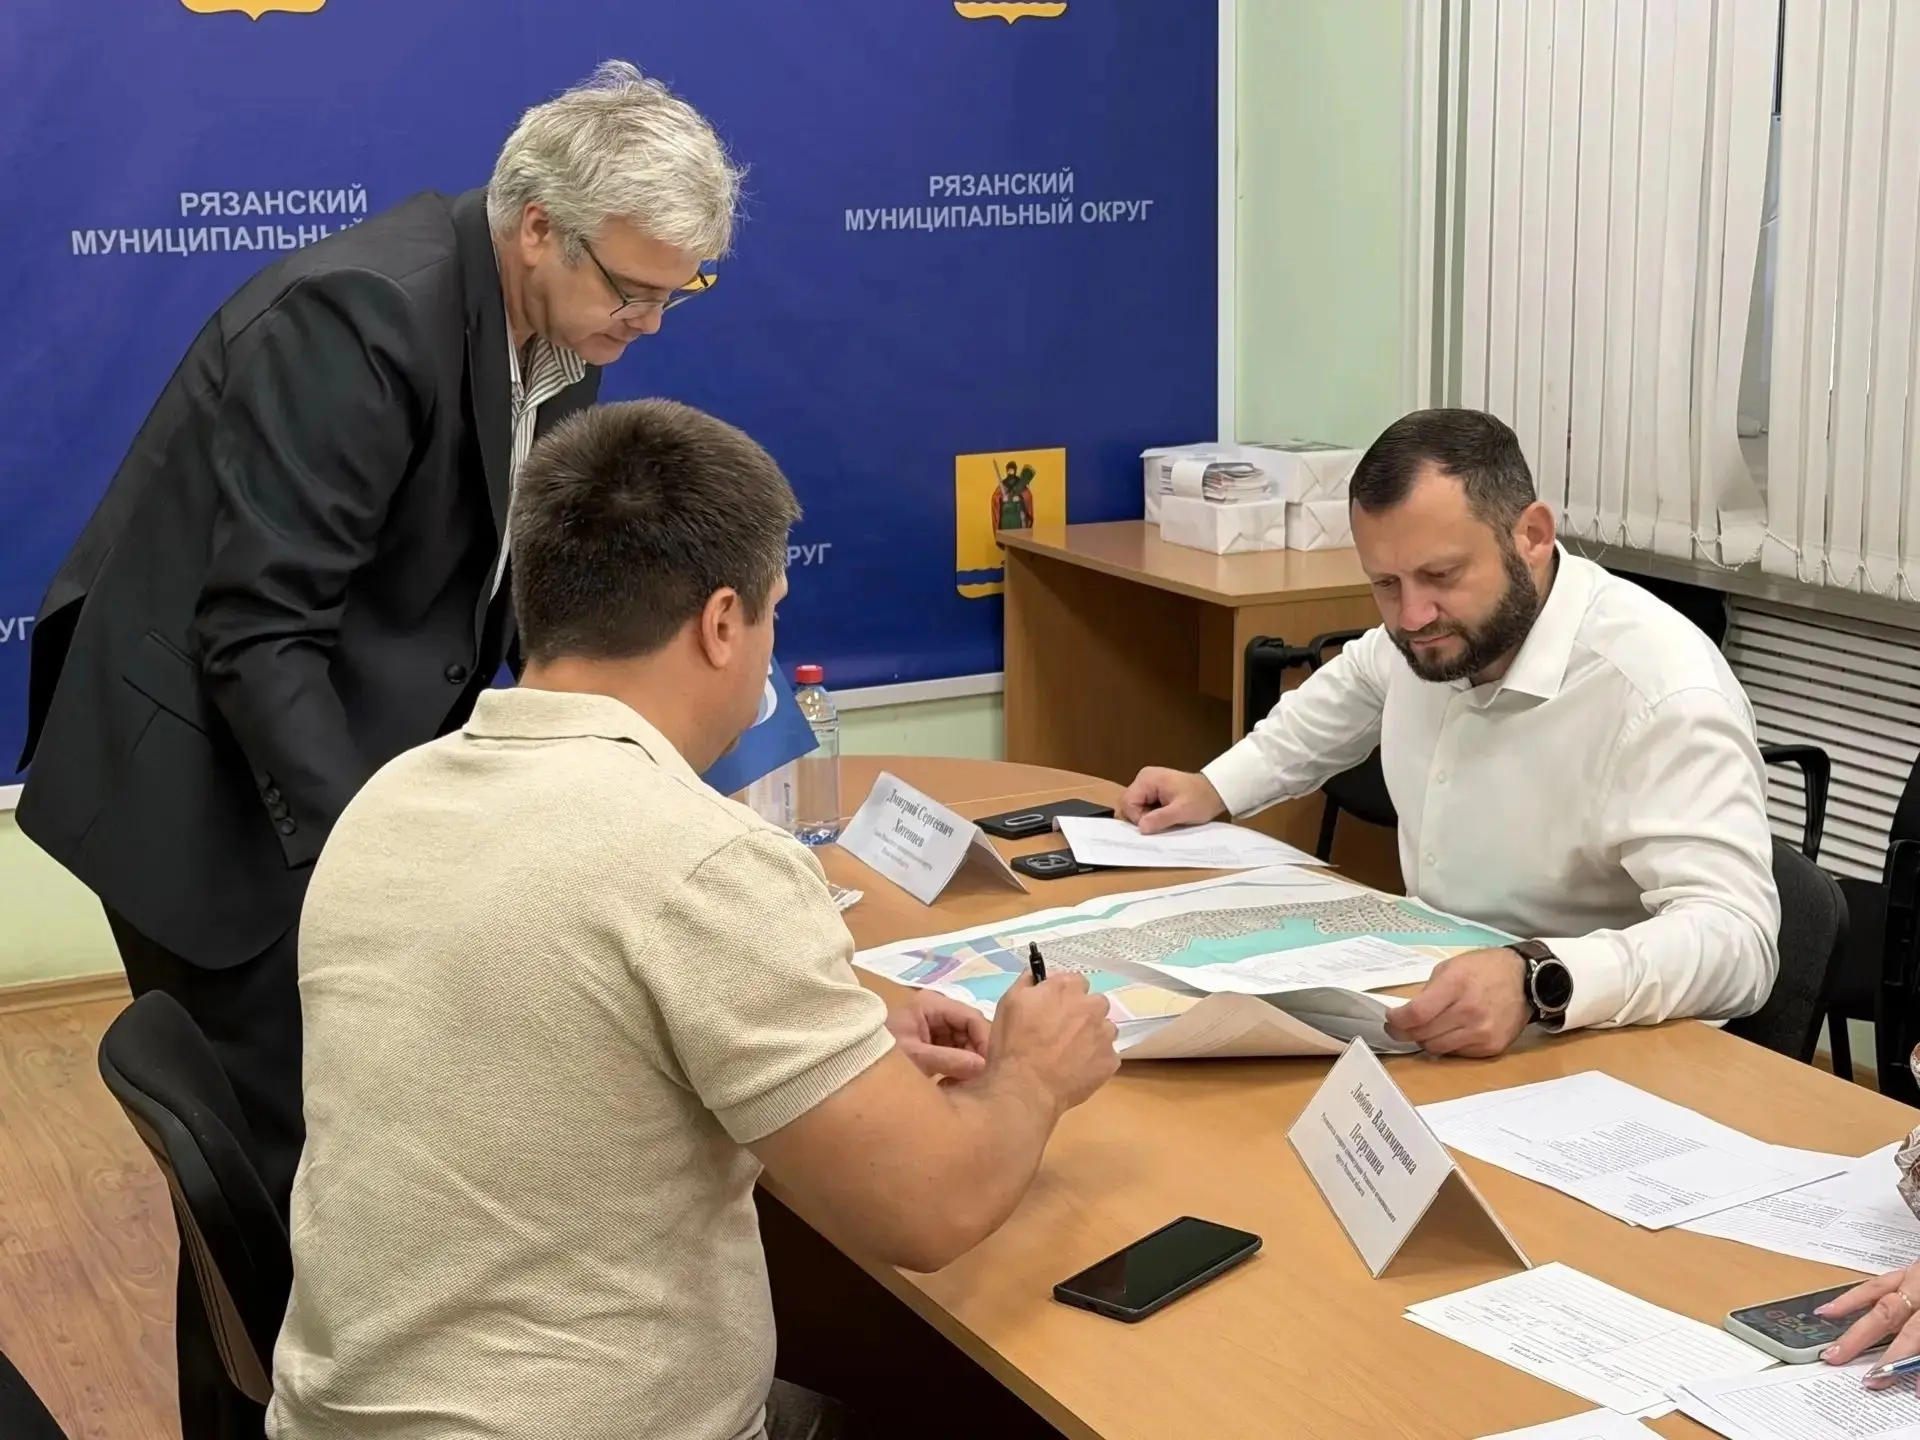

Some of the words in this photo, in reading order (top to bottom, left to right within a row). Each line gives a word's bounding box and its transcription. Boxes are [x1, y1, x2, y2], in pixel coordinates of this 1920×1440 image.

[180, 183, 368, 216] РЯЗАНСКИЙ
[929, 167, 1074, 197] РЯЗАНСКИЙ
[845, 198, 1074, 232] МУНИЦИПАЛЬНЫЙ
[1080, 200, 1154, 223] ОКРУГ
[71, 217, 363, 256] МУНИЦИПАЛЬН
[786, 542, 832, 567] РУГ
[885, 788, 921, 817] Дмитрий
[917, 806, 954, 838] Сергеевич
[1350, 1082, 1376, 1119] Любовь
[1371, 1108, 1417, 1176] Владимировна
[1348, 1123, 1385, 1176] Петрушина
